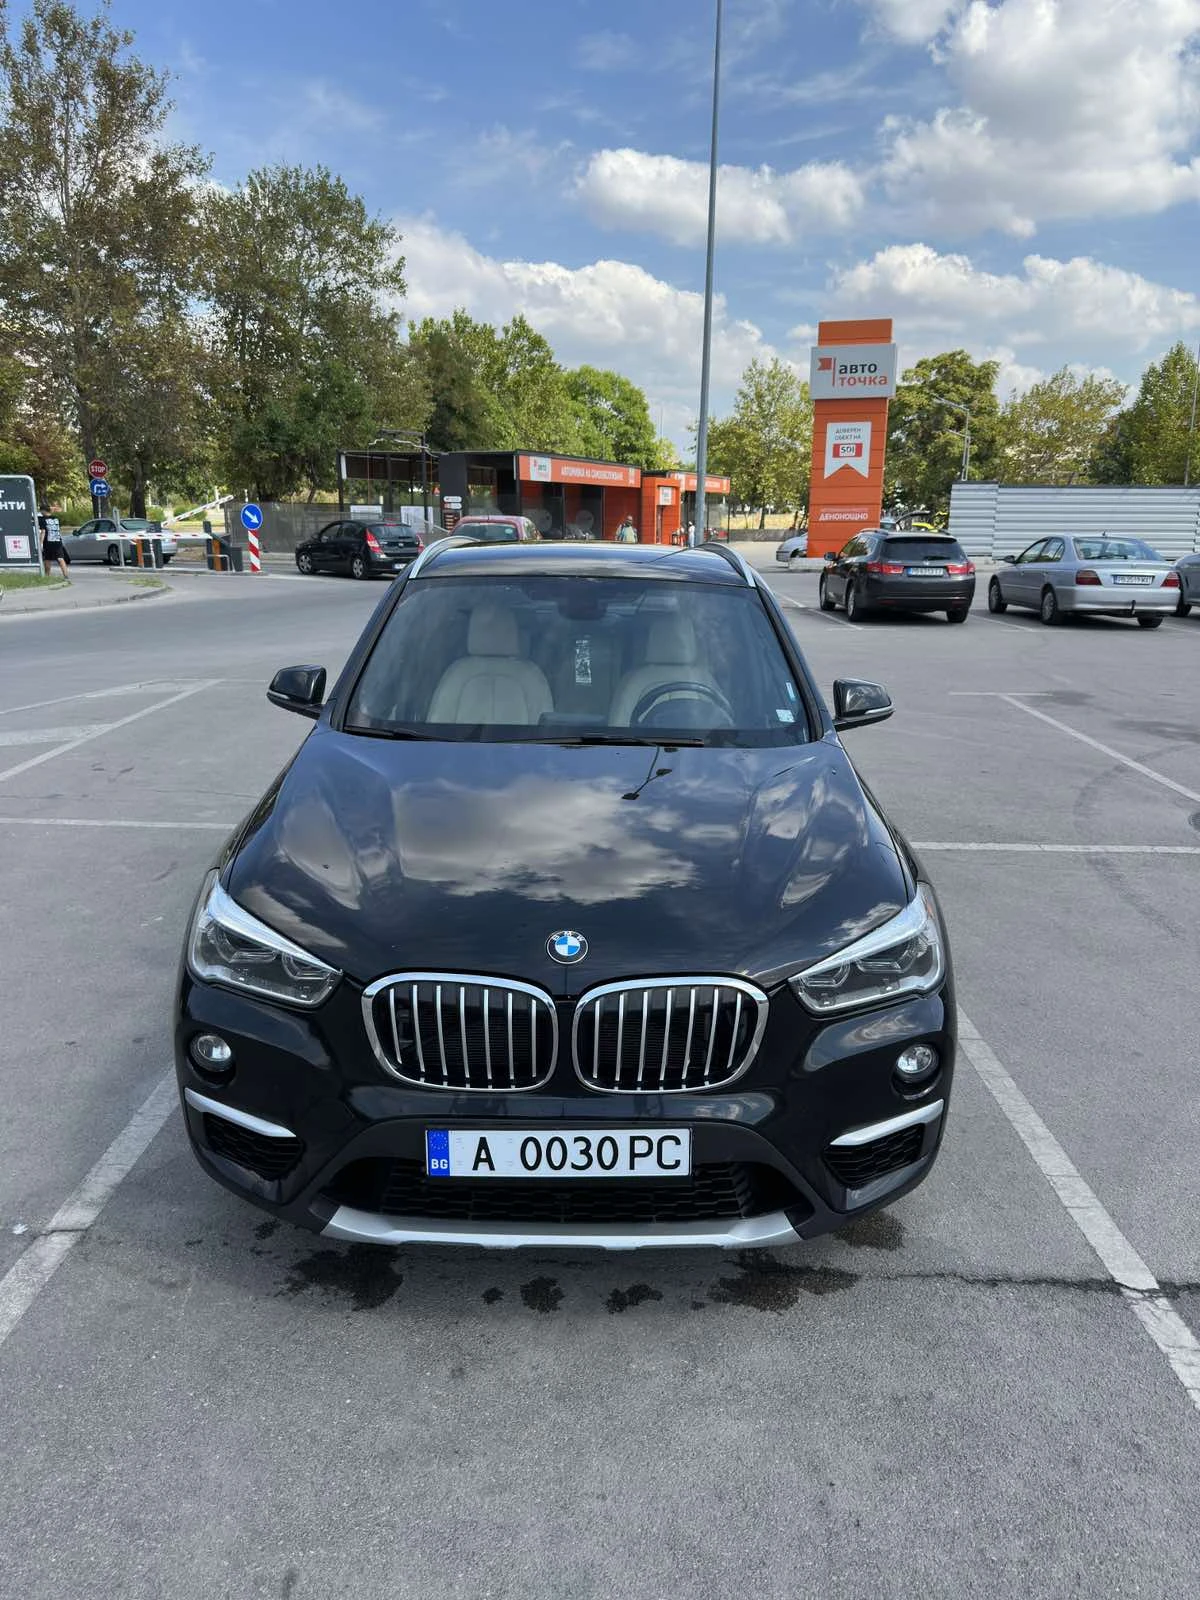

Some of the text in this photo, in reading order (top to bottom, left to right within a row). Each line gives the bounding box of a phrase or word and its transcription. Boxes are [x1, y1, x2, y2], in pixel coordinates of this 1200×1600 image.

[839, 363, 878, 374] авто
[839, 375, 888, 386] точка
[91, 465, 106, 473] STOP
[472, 1136, 496, 1171] A
[430, 1158, 449, 1170] BG
